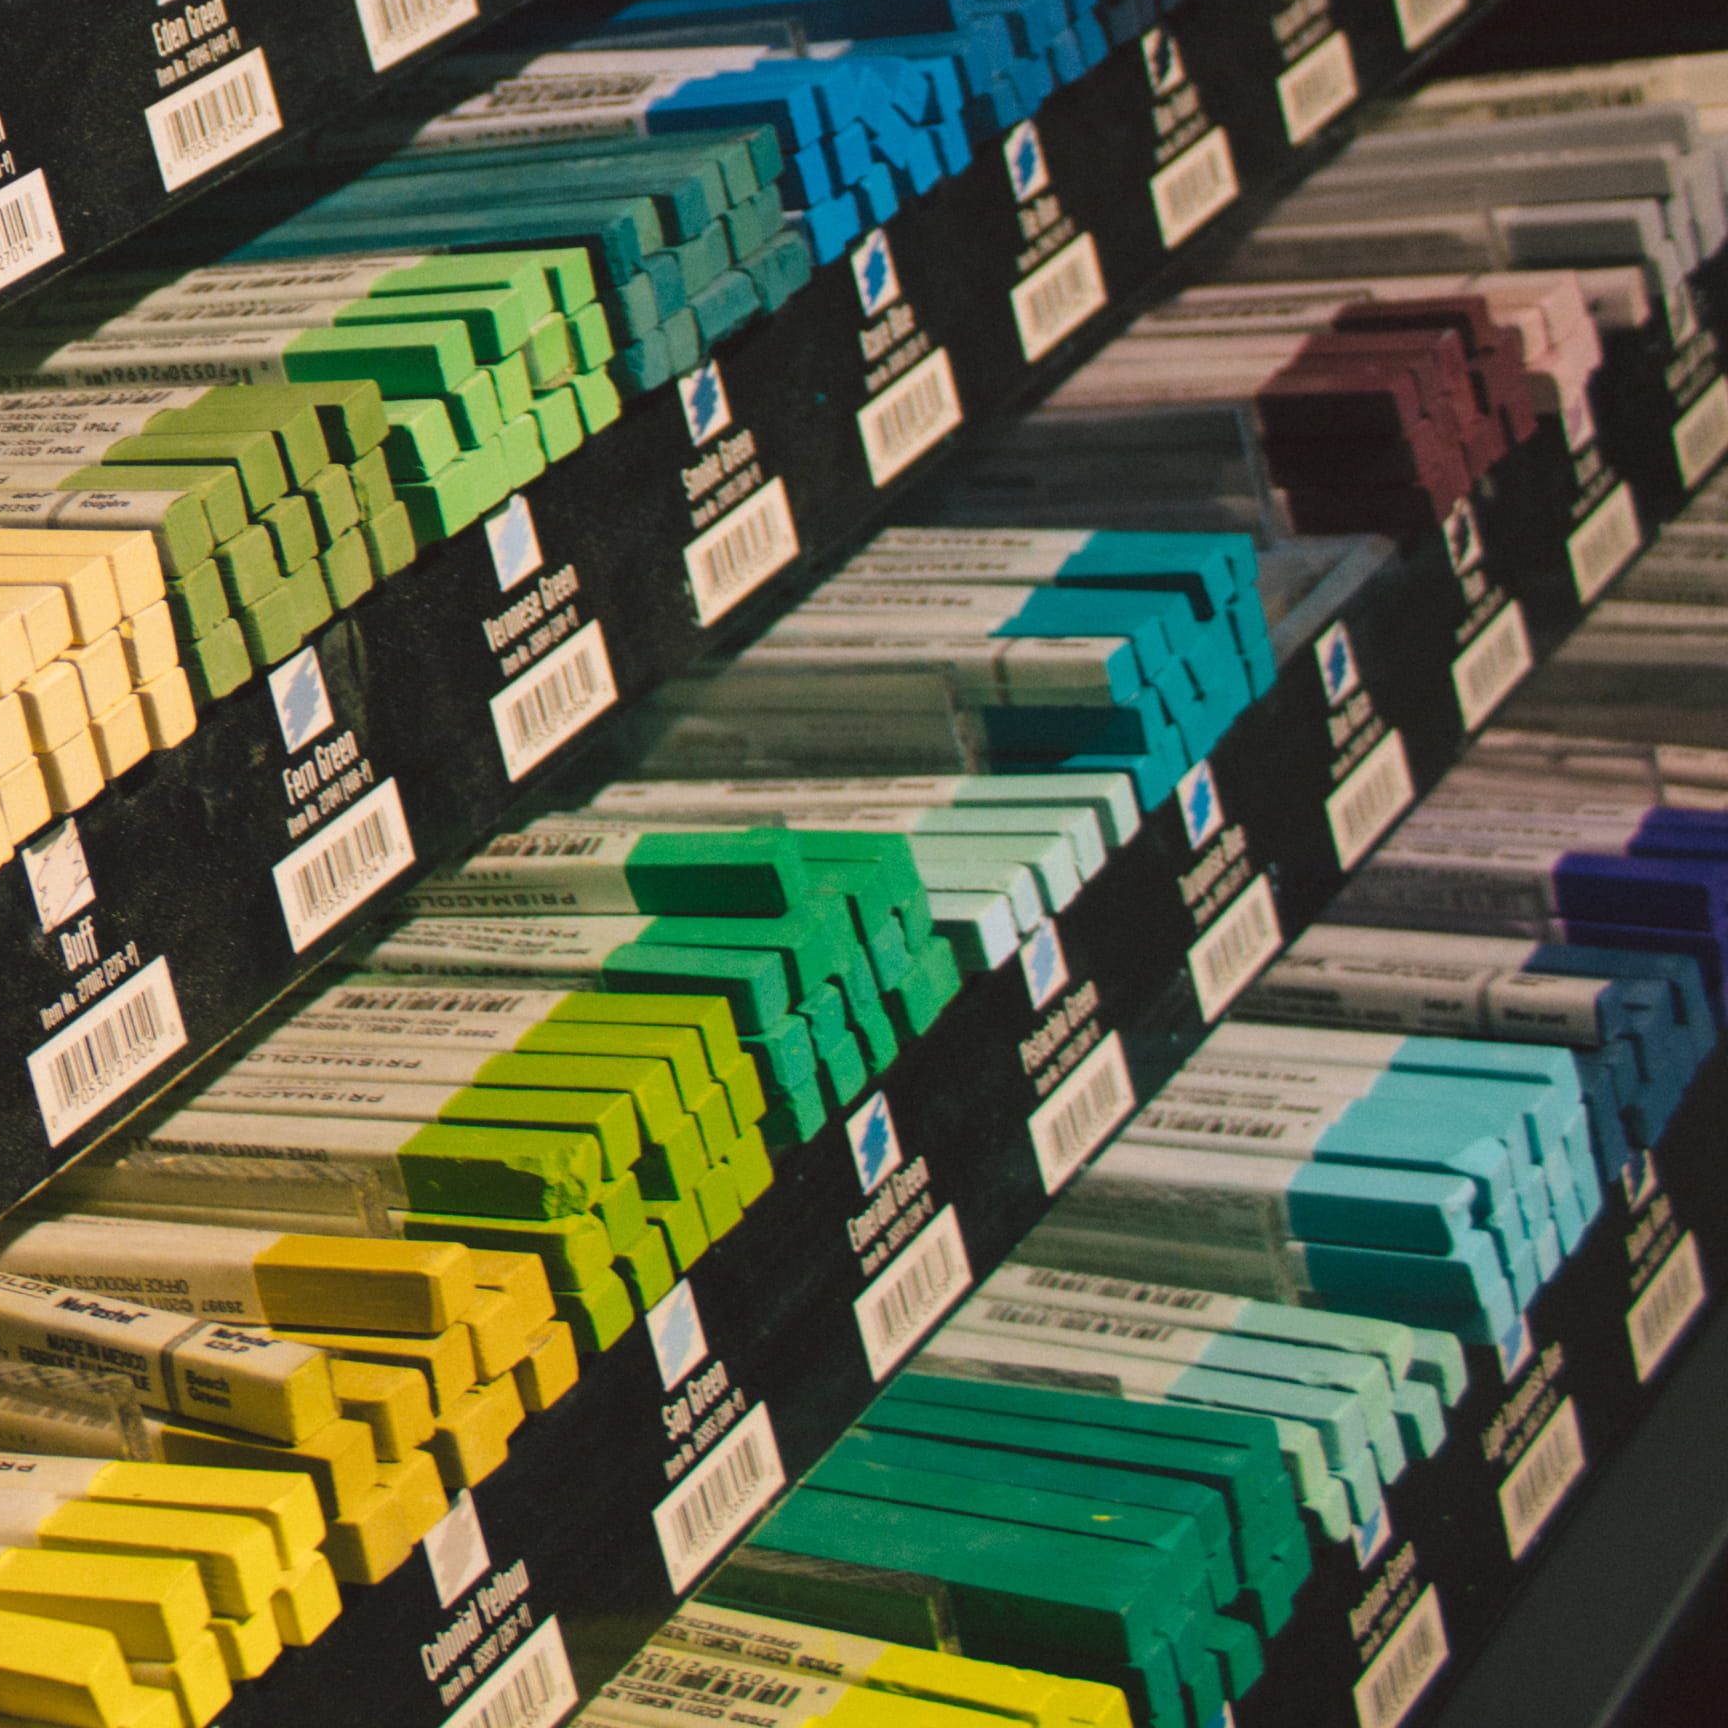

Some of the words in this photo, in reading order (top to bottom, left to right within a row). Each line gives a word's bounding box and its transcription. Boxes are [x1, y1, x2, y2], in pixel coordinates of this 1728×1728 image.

[152, 17, 189, 56] Eden
[539, 564, 579, 610] Green
[283, 760, 319, 805] Fern
[315, 731, 358, 780] Green
[60, 916, 99, 971] Buff
[891, 1156, 929, 1206] Green
[54, 1295, 136, 1325] NuPastel
[662, 1398, 692, 1440] Sap
[687, 1361, 728, 1415] Green
[477, 1560, 529, 1624] Yellow
